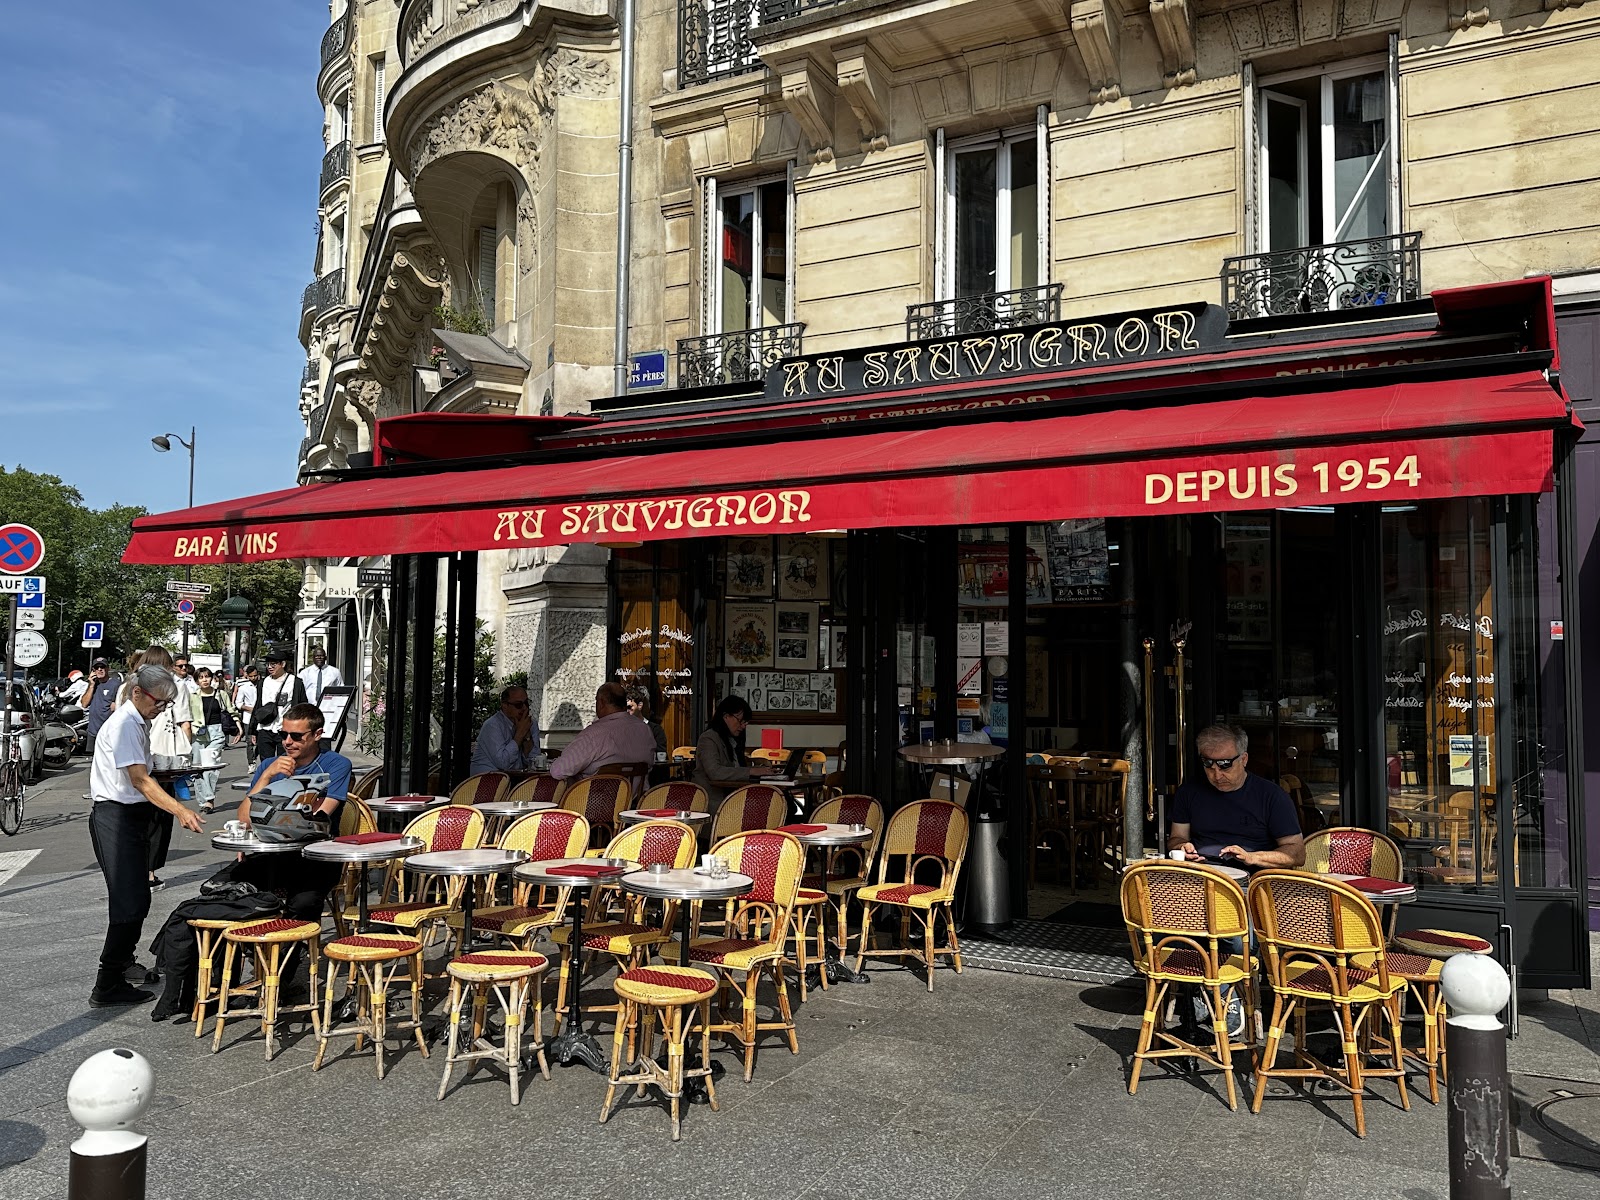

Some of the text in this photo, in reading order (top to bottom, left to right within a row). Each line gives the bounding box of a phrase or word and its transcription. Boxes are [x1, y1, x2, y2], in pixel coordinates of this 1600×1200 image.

[783, 311, 1199, 398] AU SAUVIGNON
[642, 370, 664, 382] PÈRES
[1145, 454, 1422, 505] DEPUIS 1954
[493, 490, 812, 542] AU SAUVIGNON
[174, 531, 279, 558] BAR À VINS
[1058, 588, 1098, 596] PARIS
[89, 625, 97, 637] P
